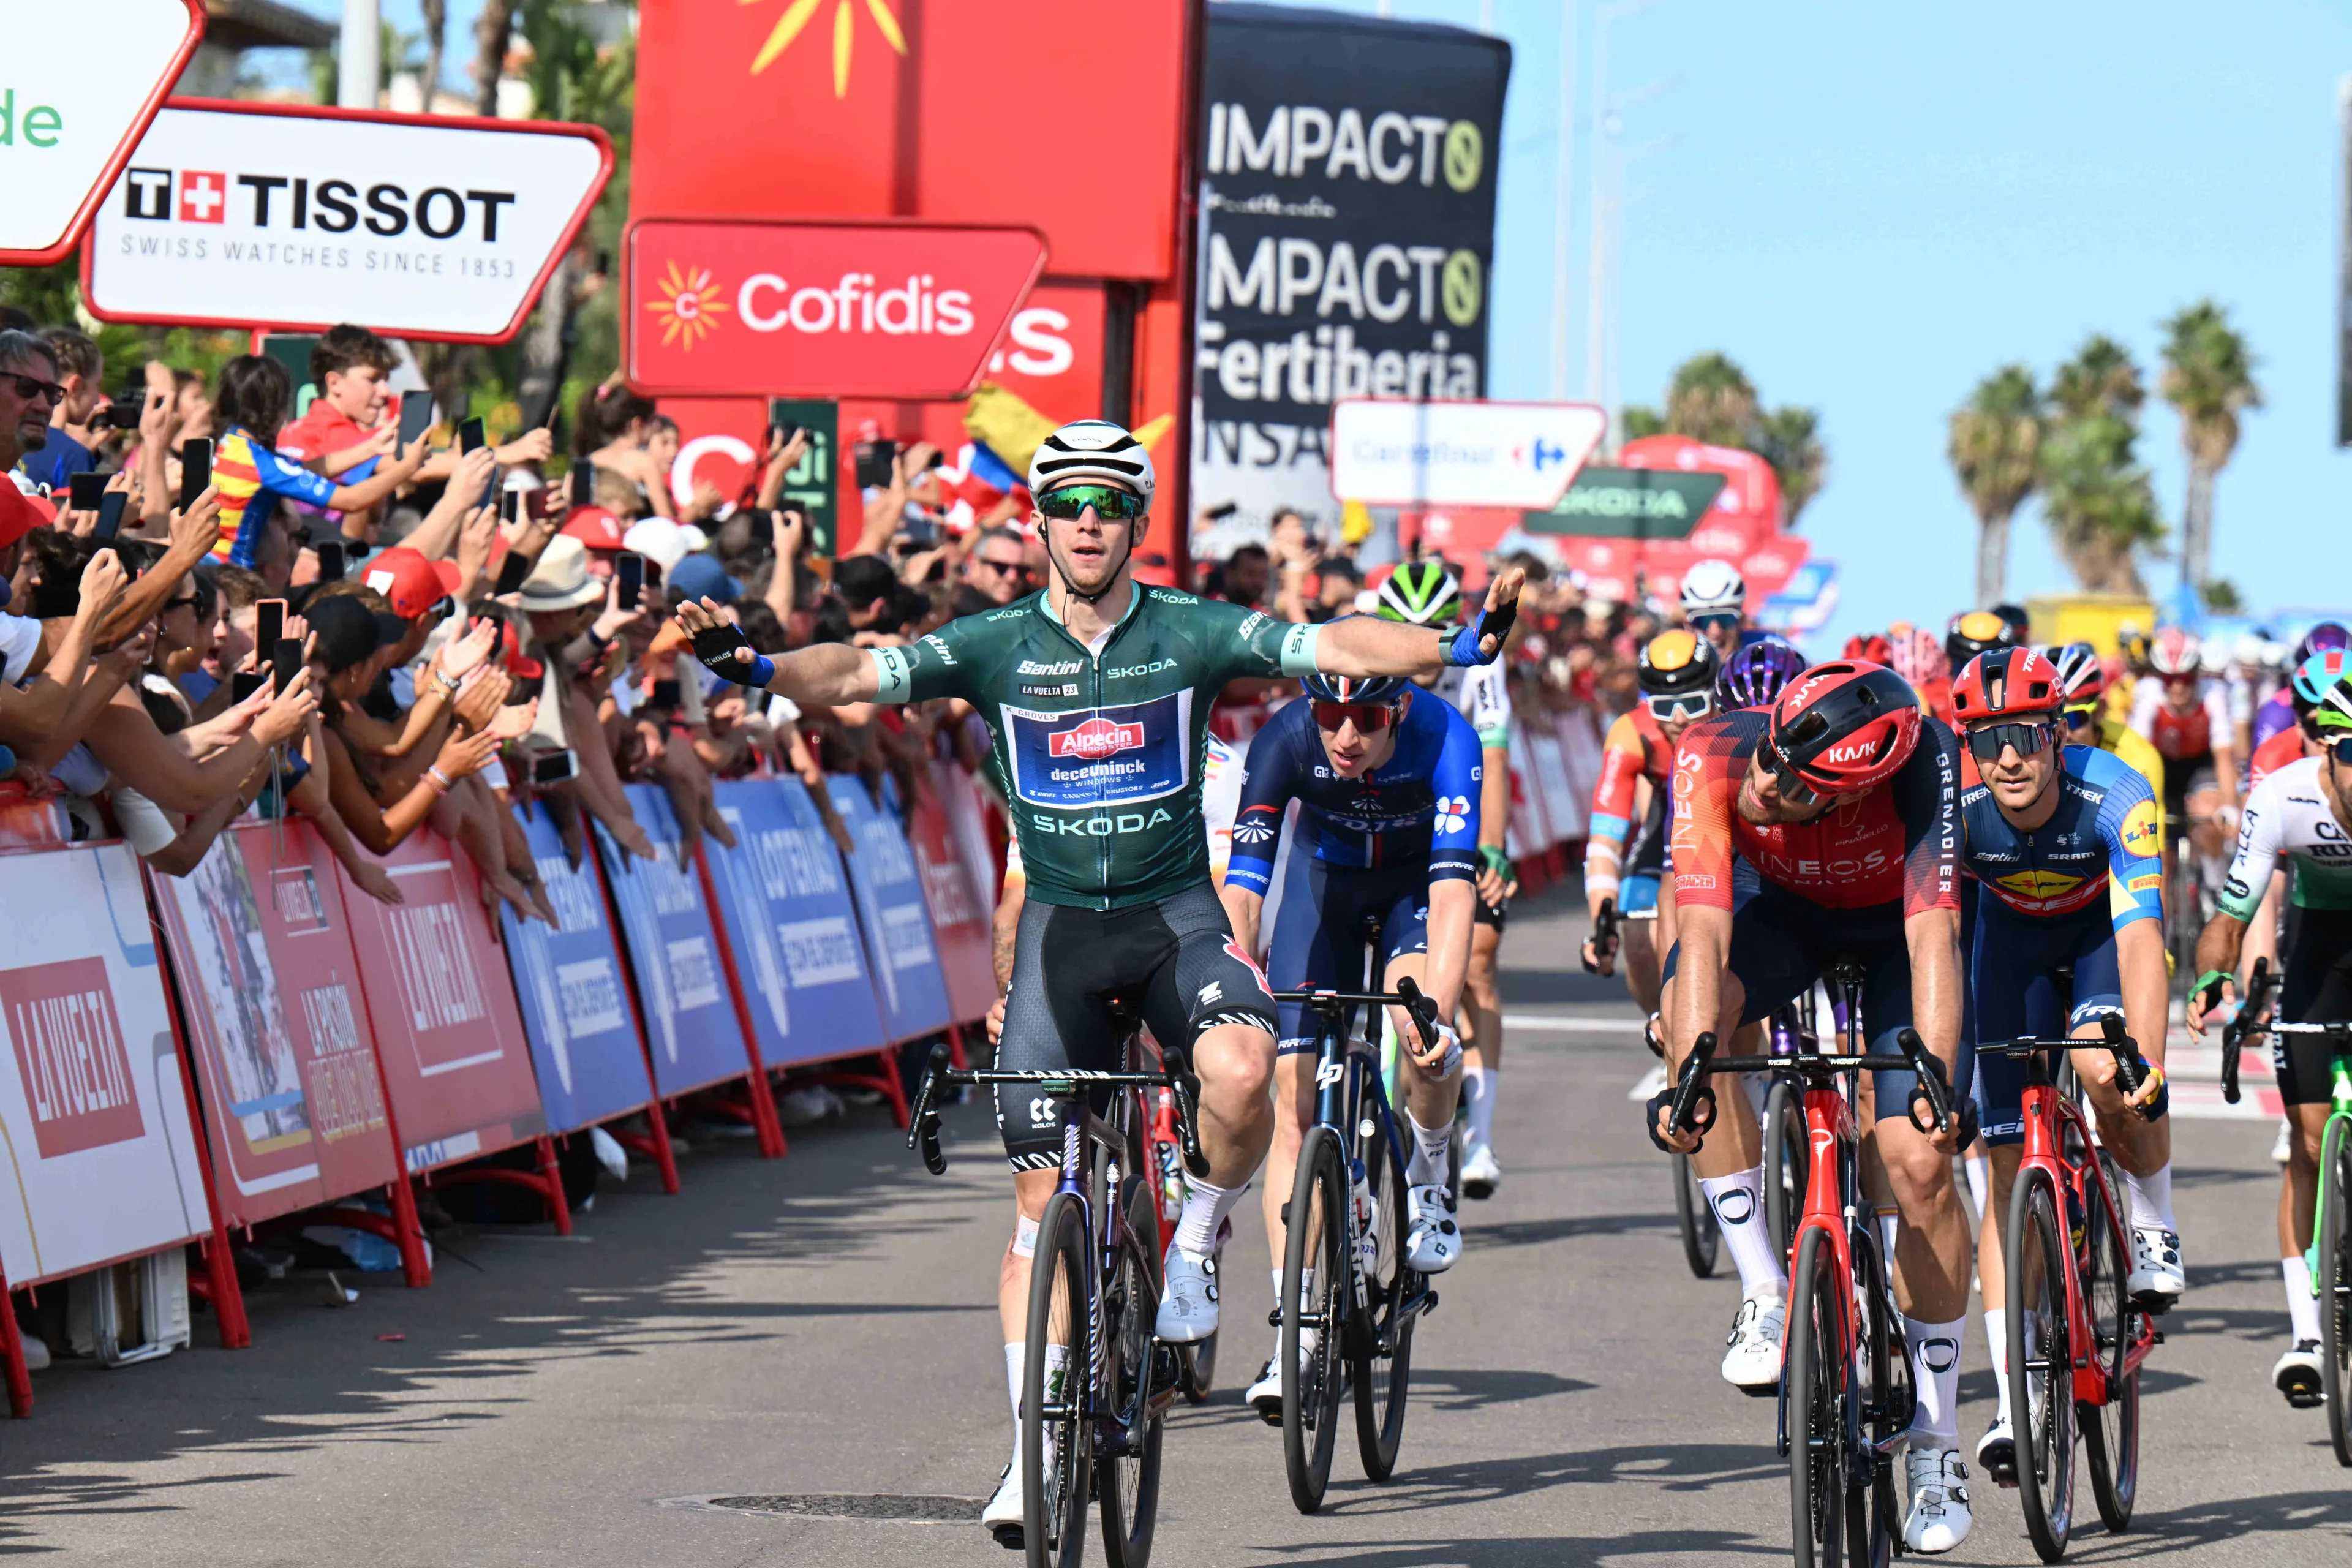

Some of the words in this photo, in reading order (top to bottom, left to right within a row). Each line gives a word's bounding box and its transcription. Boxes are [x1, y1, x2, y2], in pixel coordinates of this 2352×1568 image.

[238, 175, 515, 242] TISSOT
[121, 234, 208, 258] SWISS
[225, 241, 349, 268] WATCHES
[366, 251, 443, 274] SINCE
[461, 258, 515, 279] 1853
[737, 273, 974, 336] Cofidis
[1197, 320, 1477, 404] Fertiberia
[1149, 589, 1199, 605] SKODA
[1017, 659, 1084, 676] Santini
[1107, 658, 1178, 679] SKODA
[1023, 684, 1033, 693] LA
[1033, 685, 1060, 696] VUELTA
[1065, 685, 1076, 694] 23
[1789, 674, 1830, 707] KASK
[1018, 709, 1056, 720] GROVES
[1061, 728, 1132, 751] Alpecin
[1776, 745, 1790, 763] KASK
[1829, 741, 1877, 763] KASK
[1051, 760, 1145, 781] deceuninck
[1076, 777, 1121, 788] WINDOWS
[2066, 780, 2105, 804] TREK
[1672, 748, 1702, 849] INEOS
[1961, 786, 1991, 807] TREK
[1033, 809, 1172, 837] SKODA
[1935, 752, 1954, 893] GRENADIER
[1758, 849, 1886, 875] INEOS
[1973, 851, 2021, 862] Santini
[2048, 851, 2095, 860] SRAM
